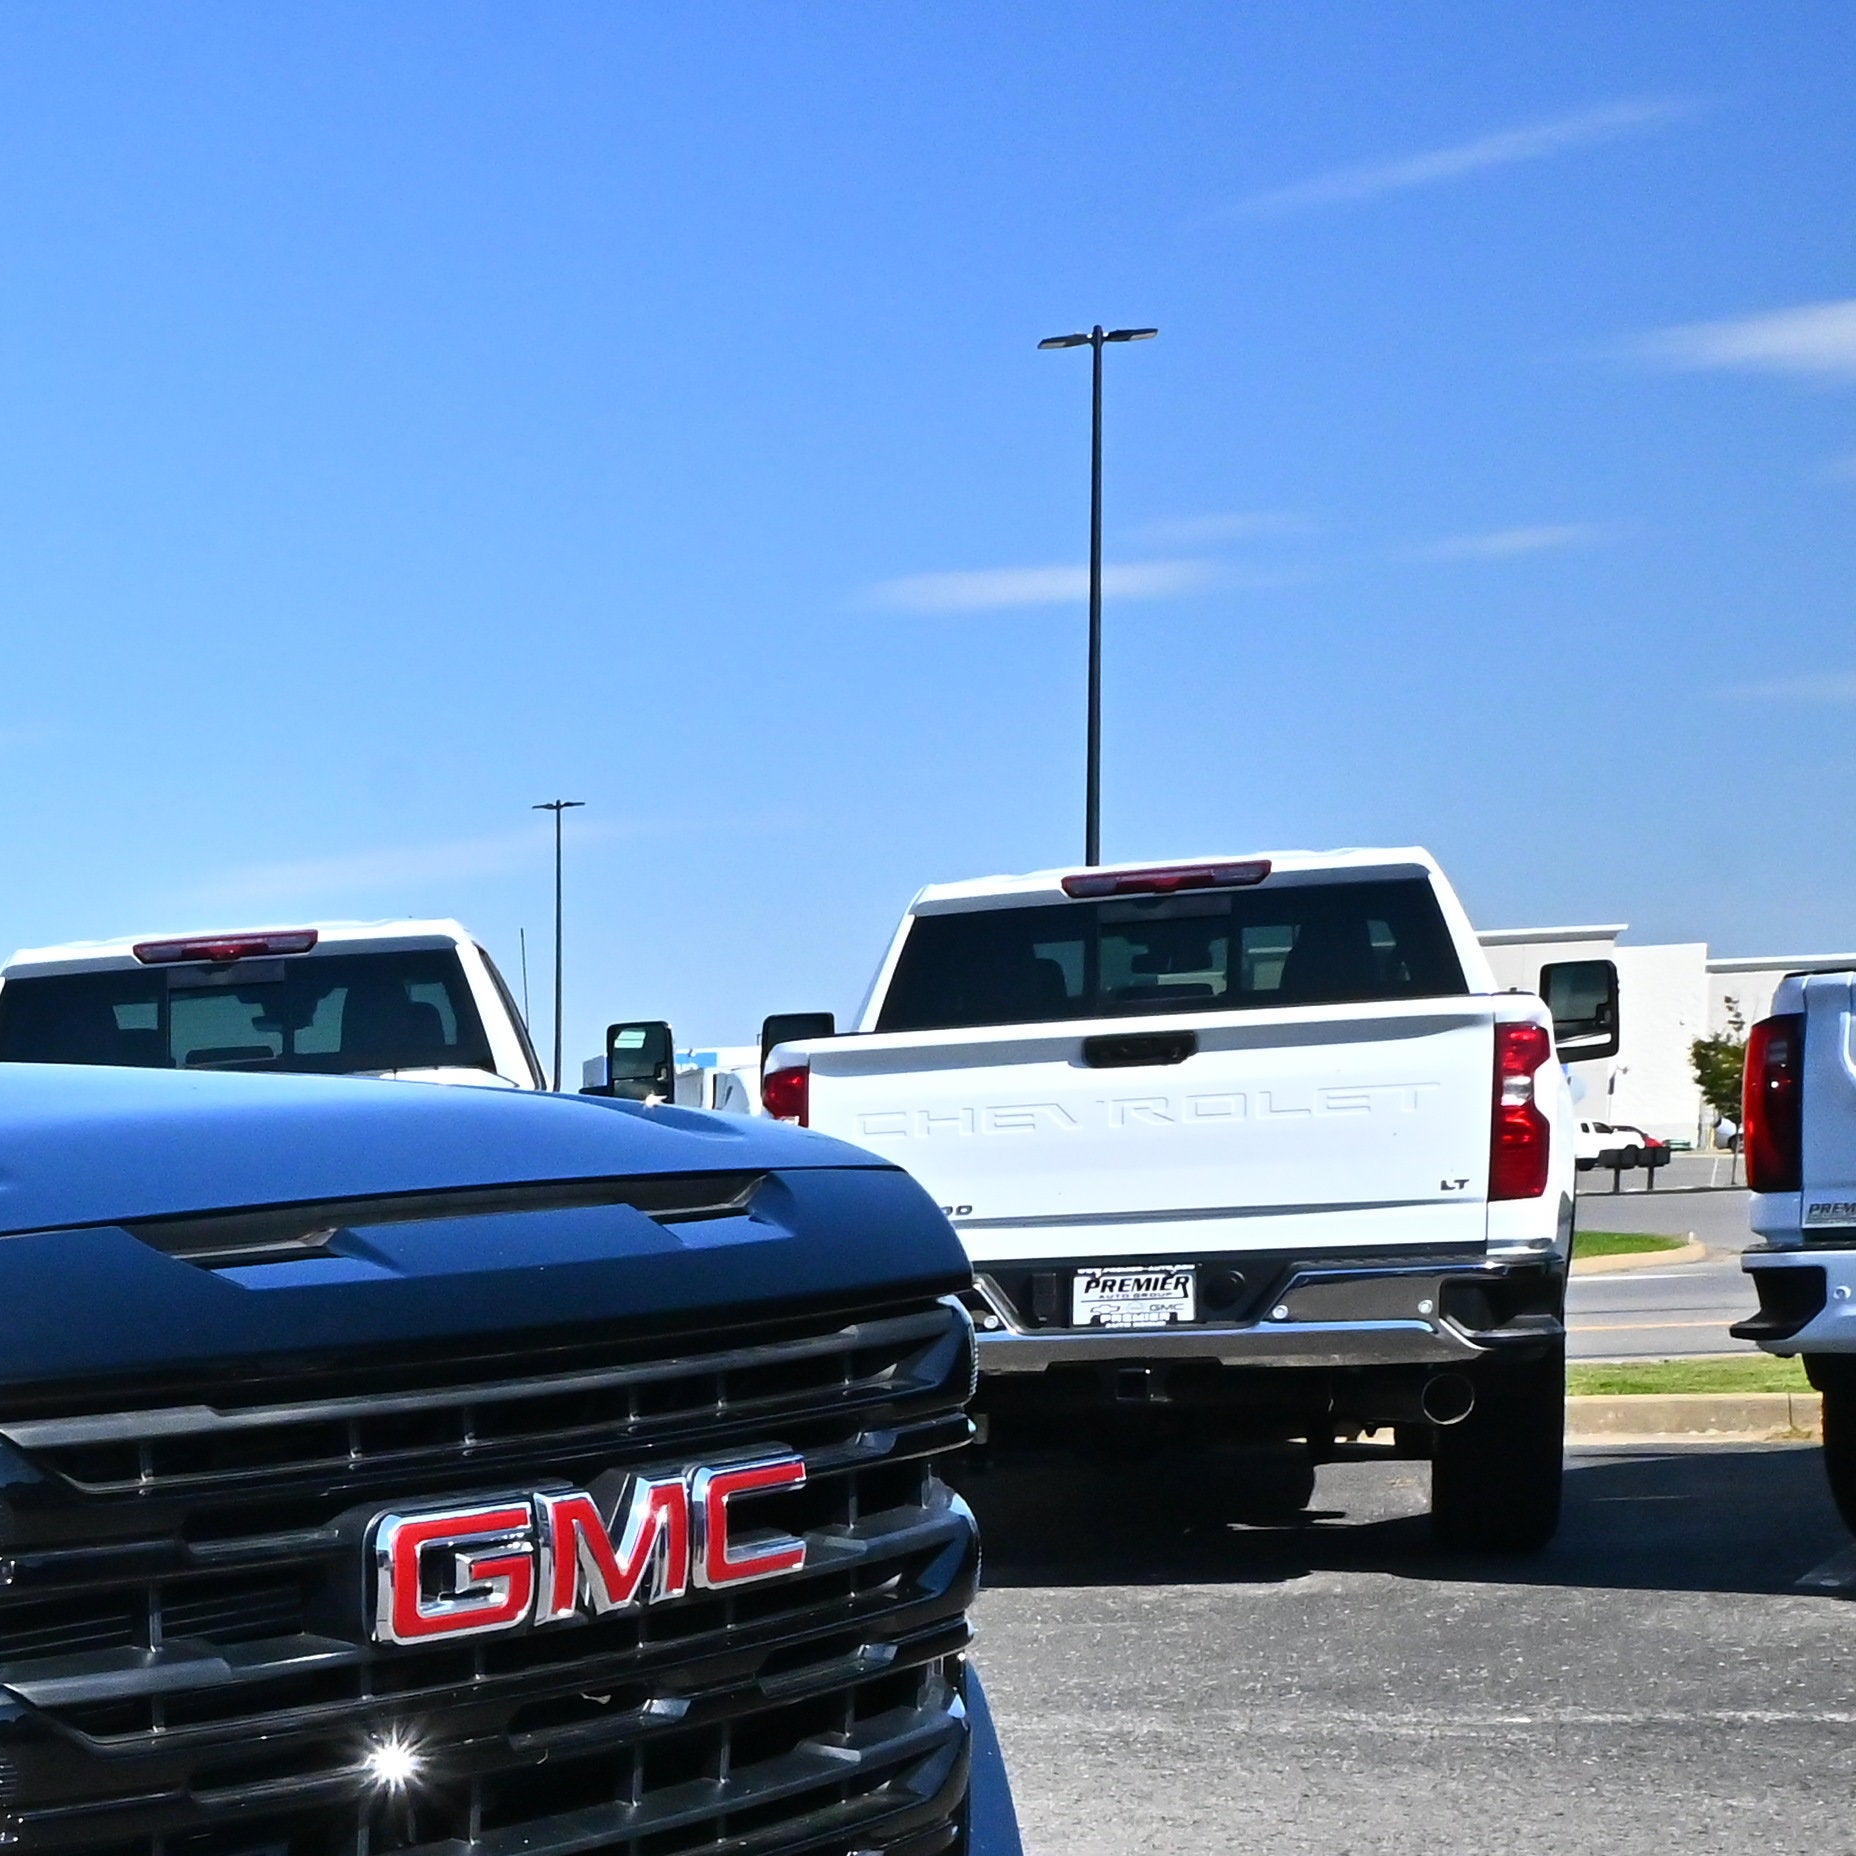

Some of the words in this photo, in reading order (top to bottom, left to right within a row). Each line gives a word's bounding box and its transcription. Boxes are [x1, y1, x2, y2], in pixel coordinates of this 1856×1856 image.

[854, 1081, 1441, 1139] CHEVROLET
[1440, 1178, 1470, 1191] LT
[1084, 1276, 1190, 1299] PREMIER
[372, 1454, 808, 1646] GMC
